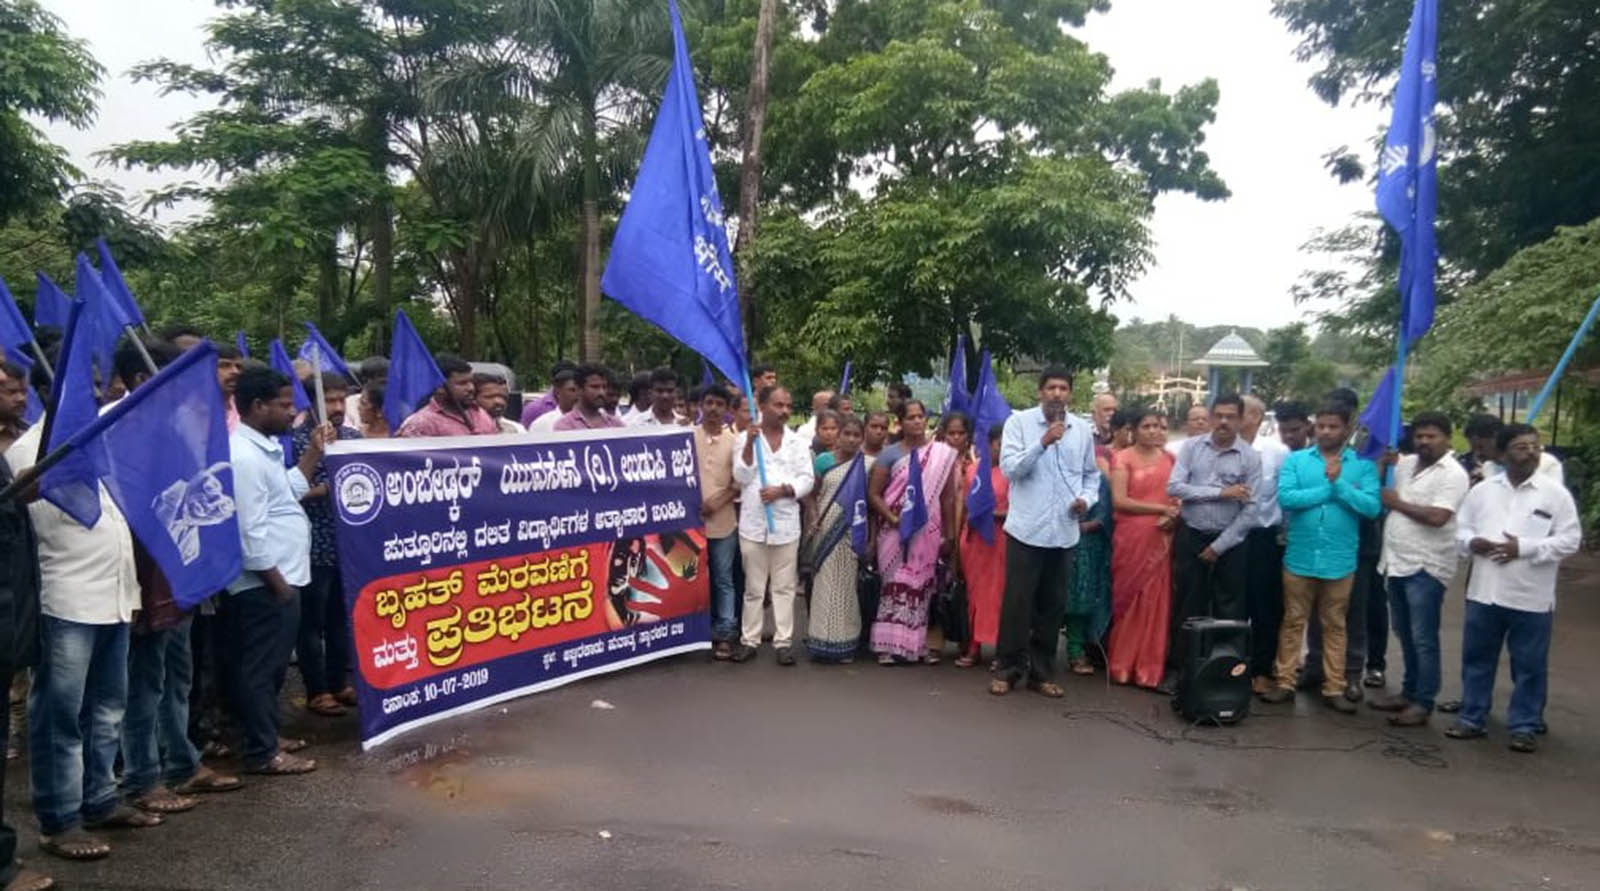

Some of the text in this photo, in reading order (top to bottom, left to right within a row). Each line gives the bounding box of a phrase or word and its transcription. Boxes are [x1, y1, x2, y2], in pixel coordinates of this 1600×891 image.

[385, 456, 482, 523] ಅಂಬೇಡ್ಕರ್
[500, 450, 583, 496] ಯುವಸೇನೆ
[584, 445, 617, 493] (ರಿ.)
[620, 444, 667, 482] ಉಡುಪಿ
[671, 439, 697, 488] ಜಿಲ್ಲೆ
[383, 525, 469, 566] ಪುತ್ತೂರಿನಲ್ಲಿ
[474, 518, 512, 548] ದಲಿತ
[594, 501, 648, 537] ಅತ್ಯಾಚಾರ
[372, 580, 595, 671] ಮತ್ತು ಪ್ರತಿಭಟನೆ
[374, 550, 590, 628] ಬೃಹತ್ ಮೆರವಣಿಗೆ
[423, 667, 490, 702] 10-07-2019
